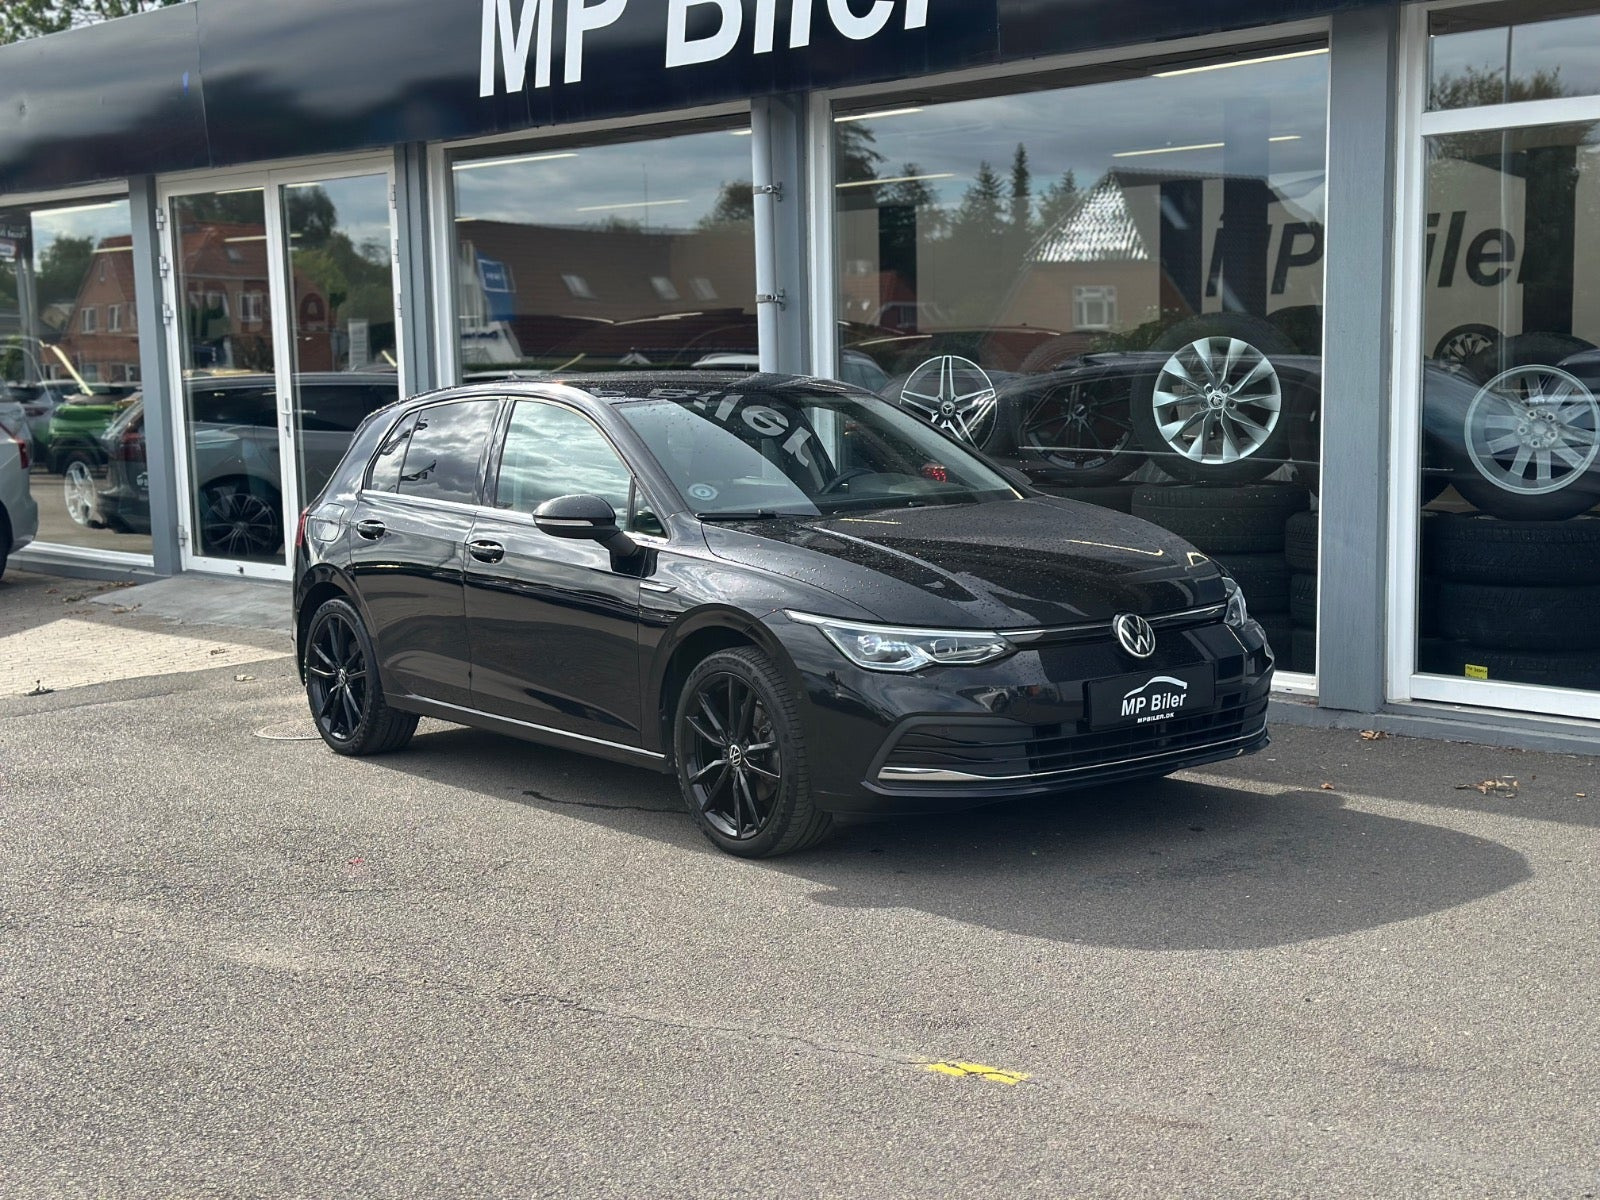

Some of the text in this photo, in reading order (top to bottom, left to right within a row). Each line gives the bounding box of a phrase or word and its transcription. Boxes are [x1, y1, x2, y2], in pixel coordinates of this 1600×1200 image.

[1121, 692, 1187, 717] MP Biler
[1136, 712, 1175, 724] MPBILER.DK
